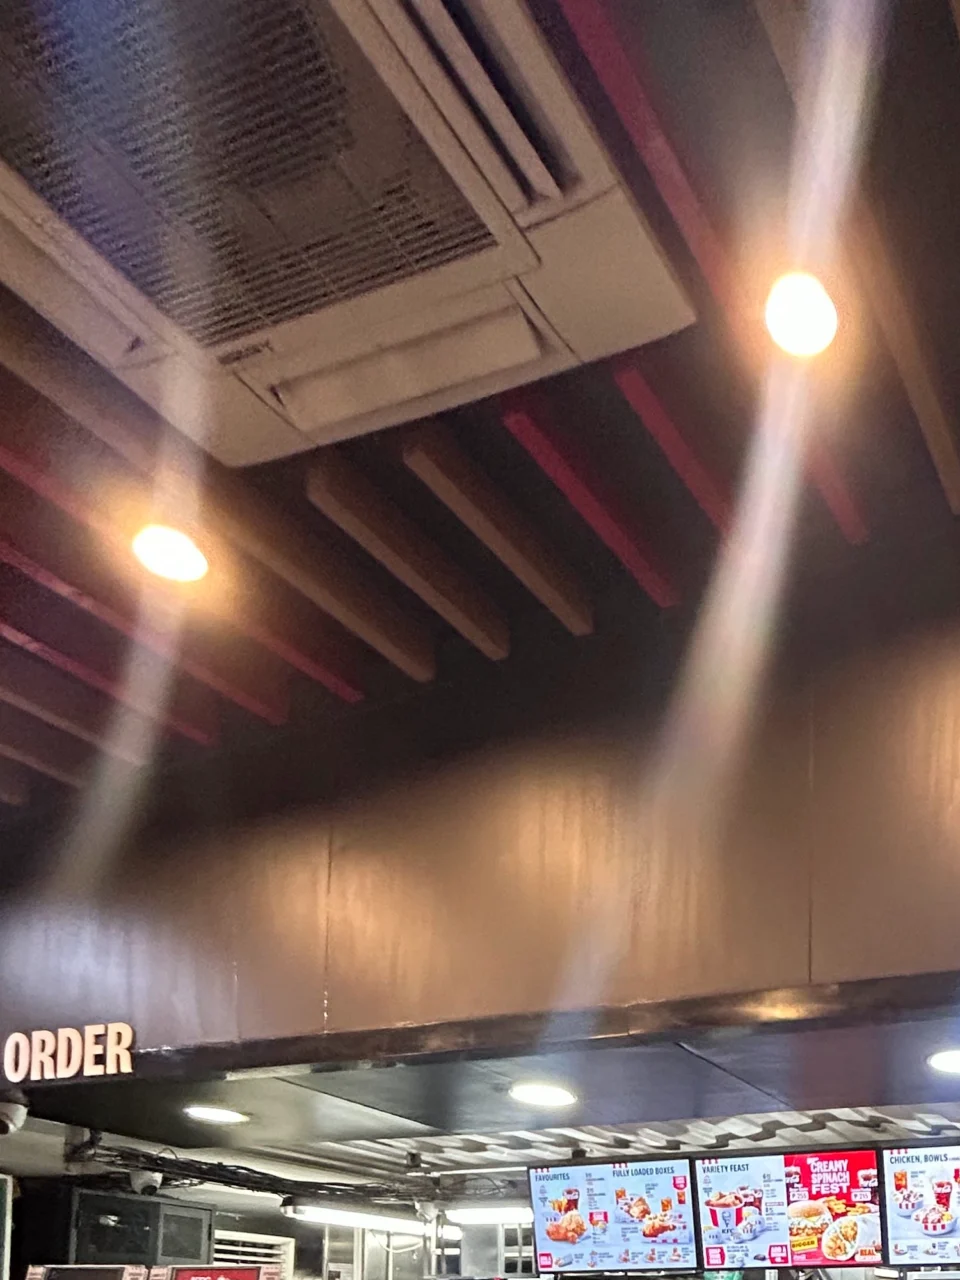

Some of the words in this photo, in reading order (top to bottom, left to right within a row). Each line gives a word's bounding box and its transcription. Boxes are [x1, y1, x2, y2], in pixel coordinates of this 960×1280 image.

[4, 1022, 133, 1083] ORDER
[889, 1155, 923, 1165] CHICKEN,
[924, 1153, 949, 1163] BOWLS
[702, 1165, 729, 1174] VARIETY
[730, 1163, 750, 1172] FEAST
[810, 1159, 848, 1172] CREAMY
[535, 1172, 571, 1182] FAVOURITES
[612, 1169, 630, 1178] FULLY
[630, 1167, 654, 1176] LOADED
[655, 1166, 675, 1175] BOXES
[810, 1171, 850, 1184] SPINACH
[811, 1183, 850, 1195] FEST
